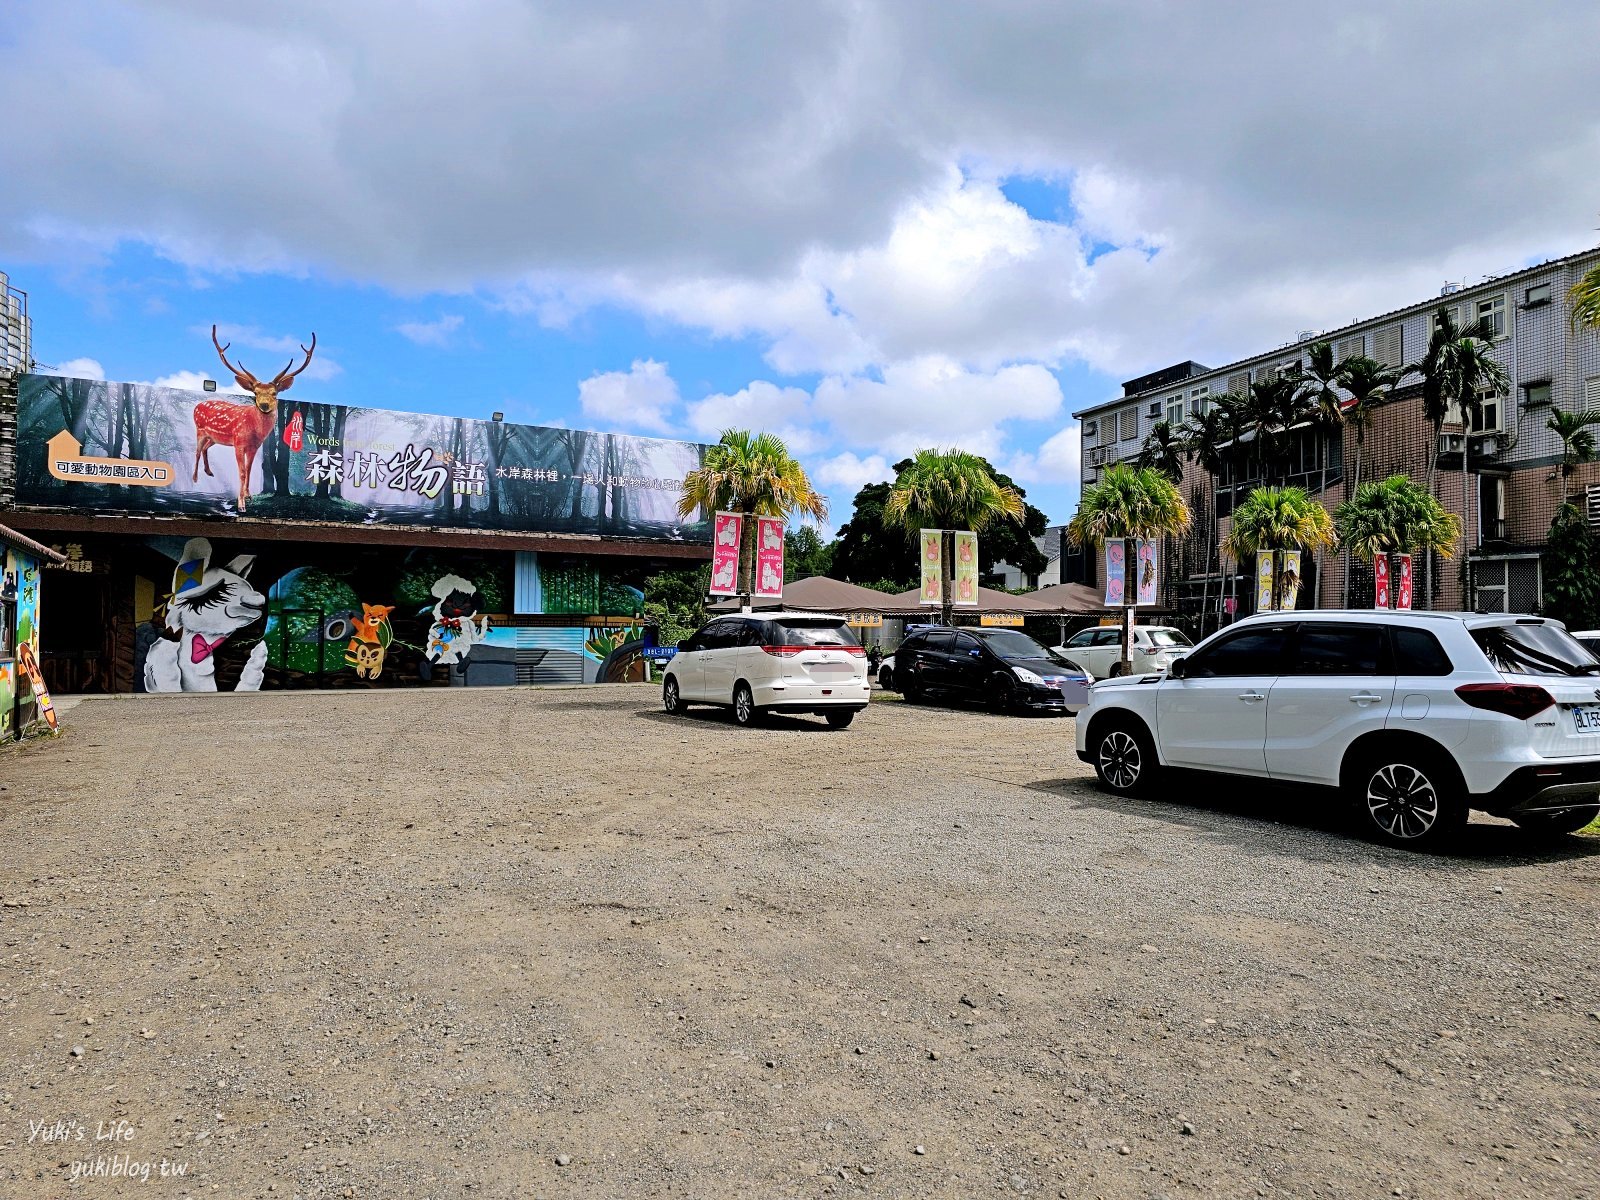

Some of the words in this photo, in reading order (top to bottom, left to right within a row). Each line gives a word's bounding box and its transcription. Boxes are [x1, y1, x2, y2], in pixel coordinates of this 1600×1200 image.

[307, 434, 340, 447] Words
[56, 461, 167, 480] 可愛動物園區入口
[305, 444, 487, 499] 森林物語
